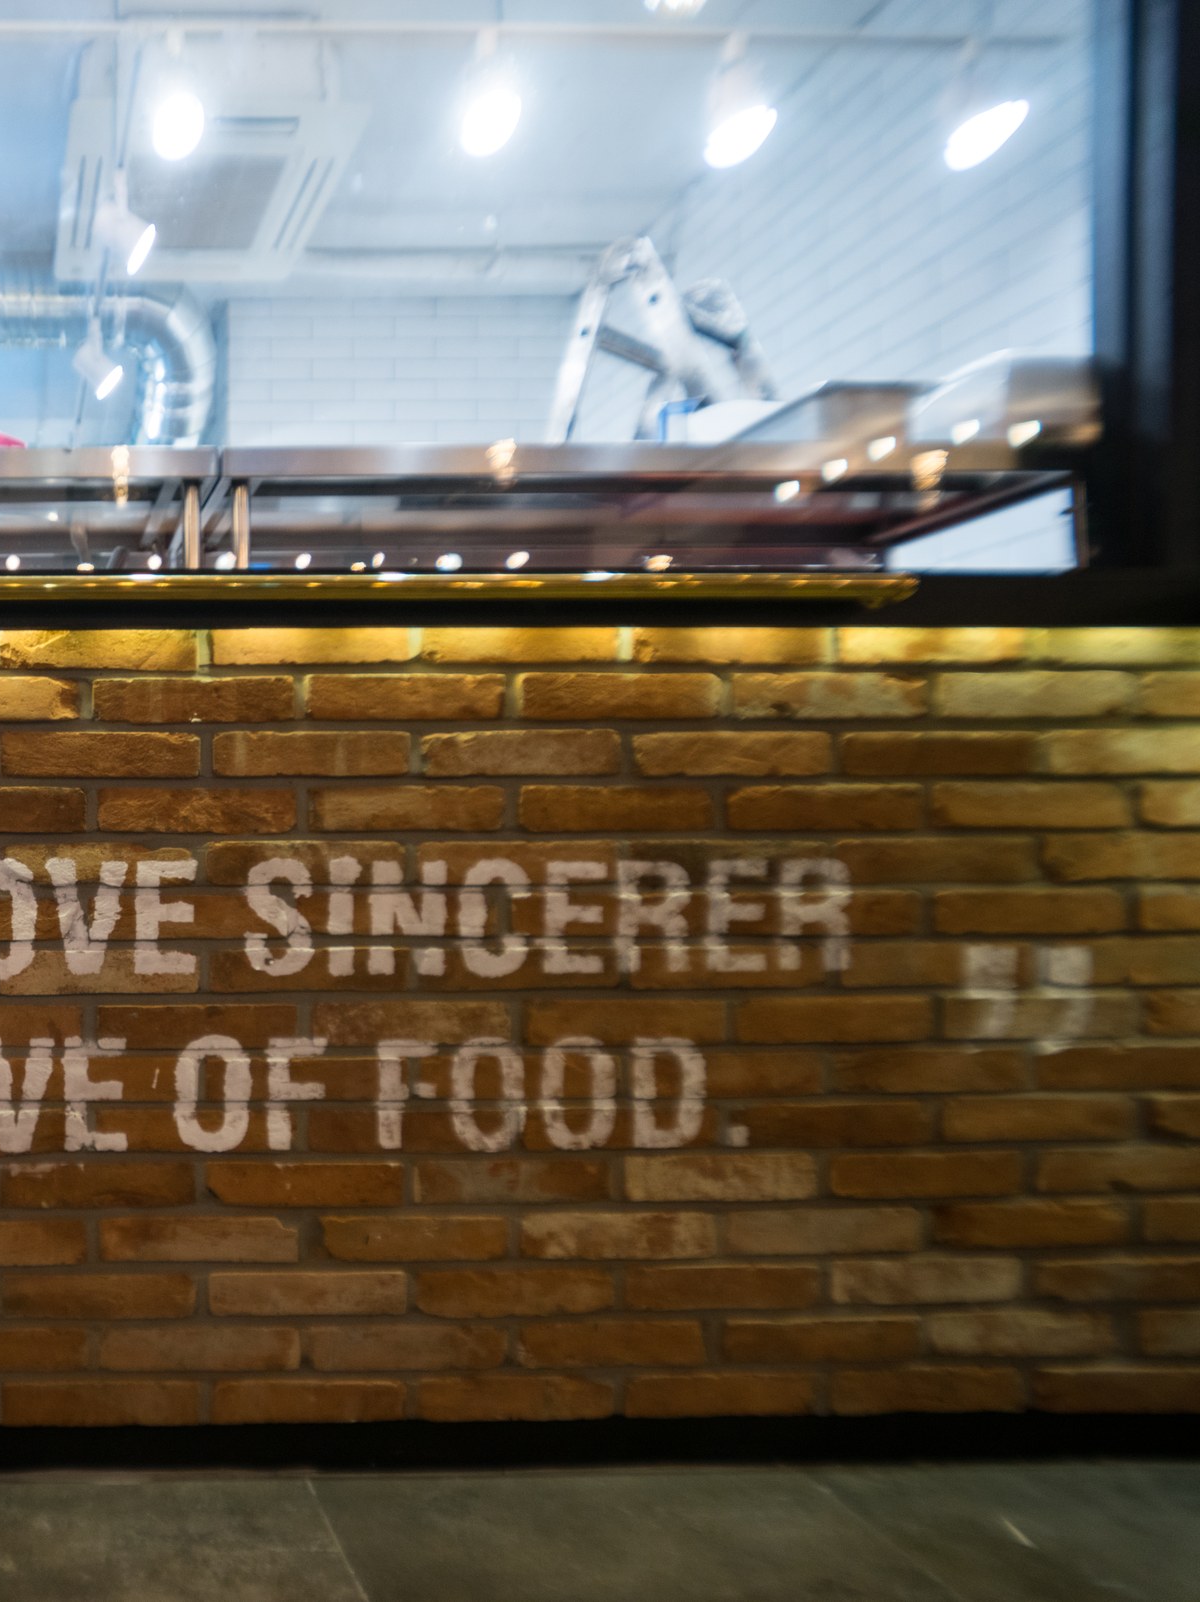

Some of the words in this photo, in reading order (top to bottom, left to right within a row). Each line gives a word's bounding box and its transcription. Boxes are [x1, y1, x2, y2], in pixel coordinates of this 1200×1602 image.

[244, 856, 852, 977] SINCERER
[174, 1034, 328, 1152] OF
[376, 1036, 749, 1153] FOOD.
